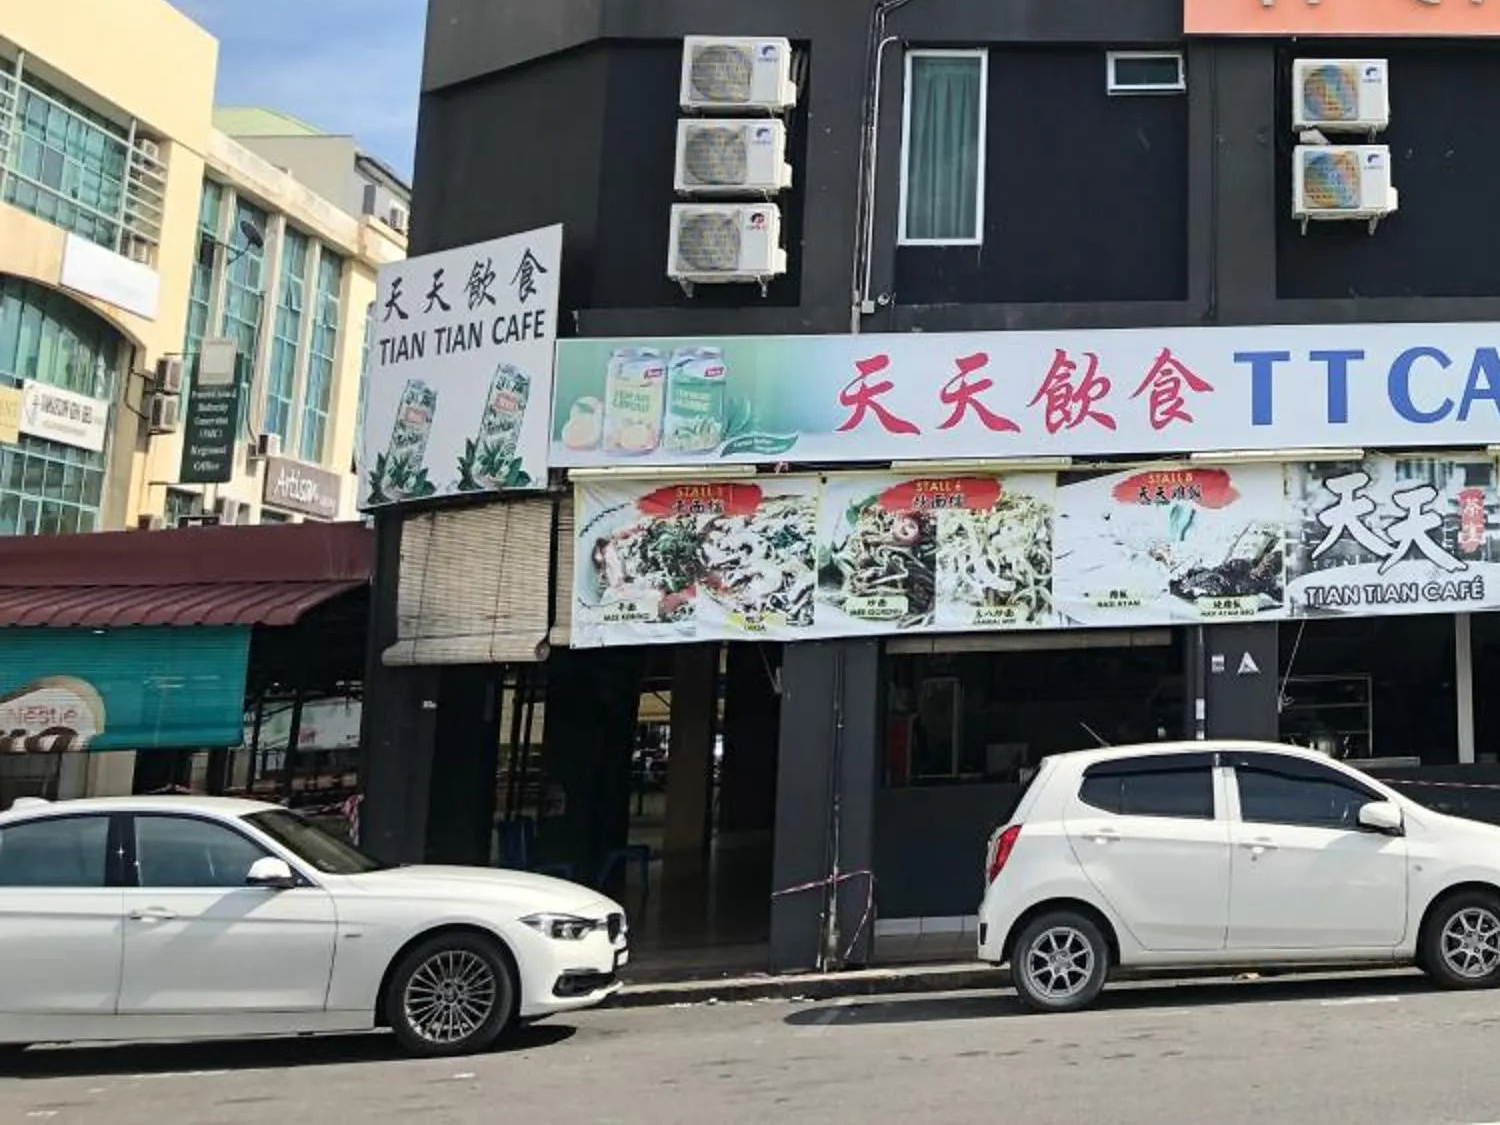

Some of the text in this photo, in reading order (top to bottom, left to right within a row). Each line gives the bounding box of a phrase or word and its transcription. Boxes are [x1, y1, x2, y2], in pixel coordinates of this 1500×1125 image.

[382, 247, 548, 323] 天天飲食
[379, 310, 546, 367] TIAN TIAN CAFE
[835, 347, 1215, 436] 天天飲食
[915, 481, 952, 493] STALL
[1310, 471, 1469, 575] 天天
[1304, 584, 1361, 606] TIAN
[1362, 582, 1420, 604] TIAN
